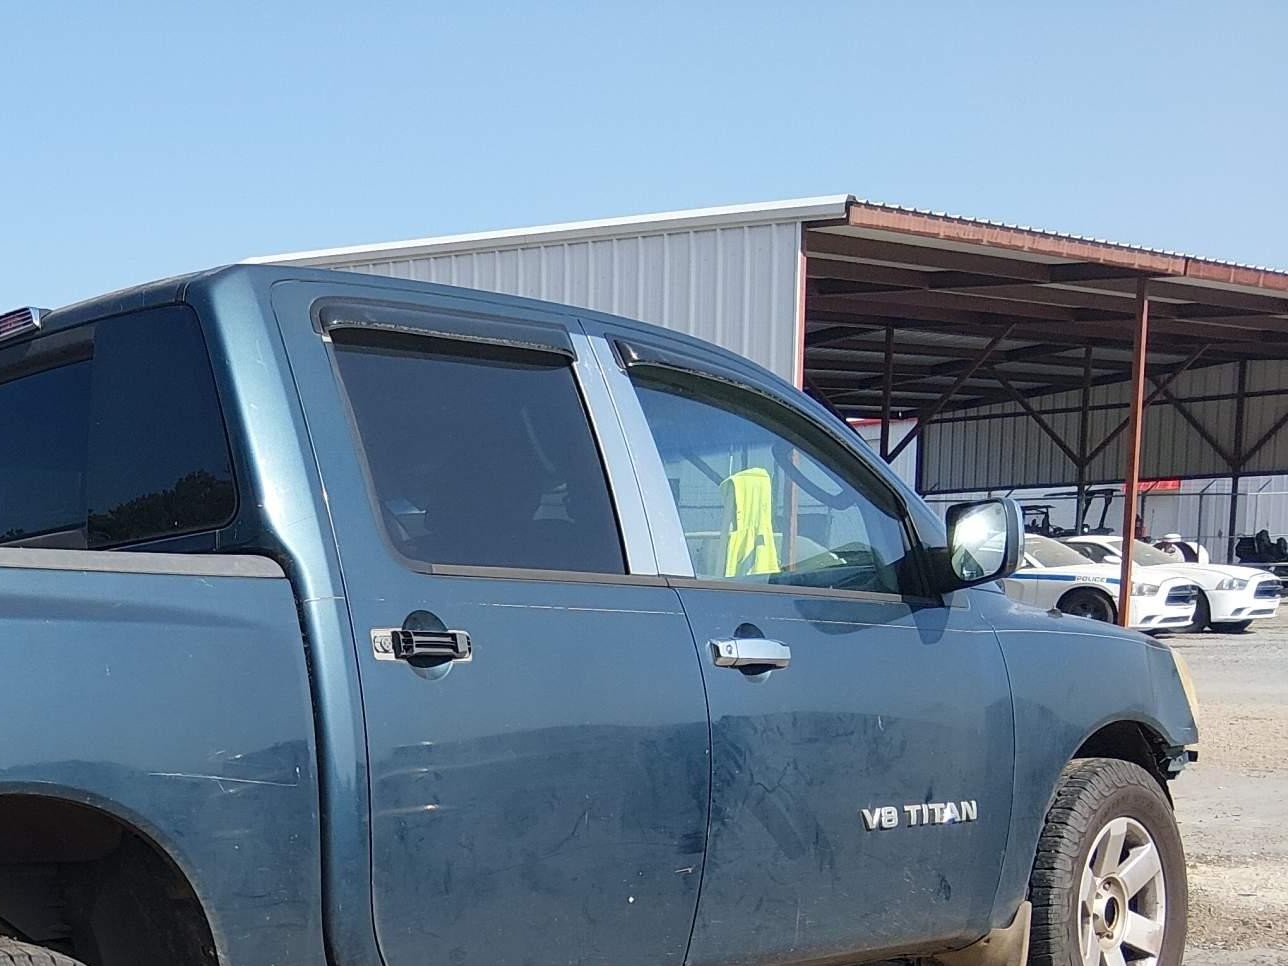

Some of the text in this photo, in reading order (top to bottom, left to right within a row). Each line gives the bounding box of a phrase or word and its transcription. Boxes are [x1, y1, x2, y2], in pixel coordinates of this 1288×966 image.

[1076, 575, 1106, 583] POLICE
[861, 800, 978, 830] V8 TITAN
